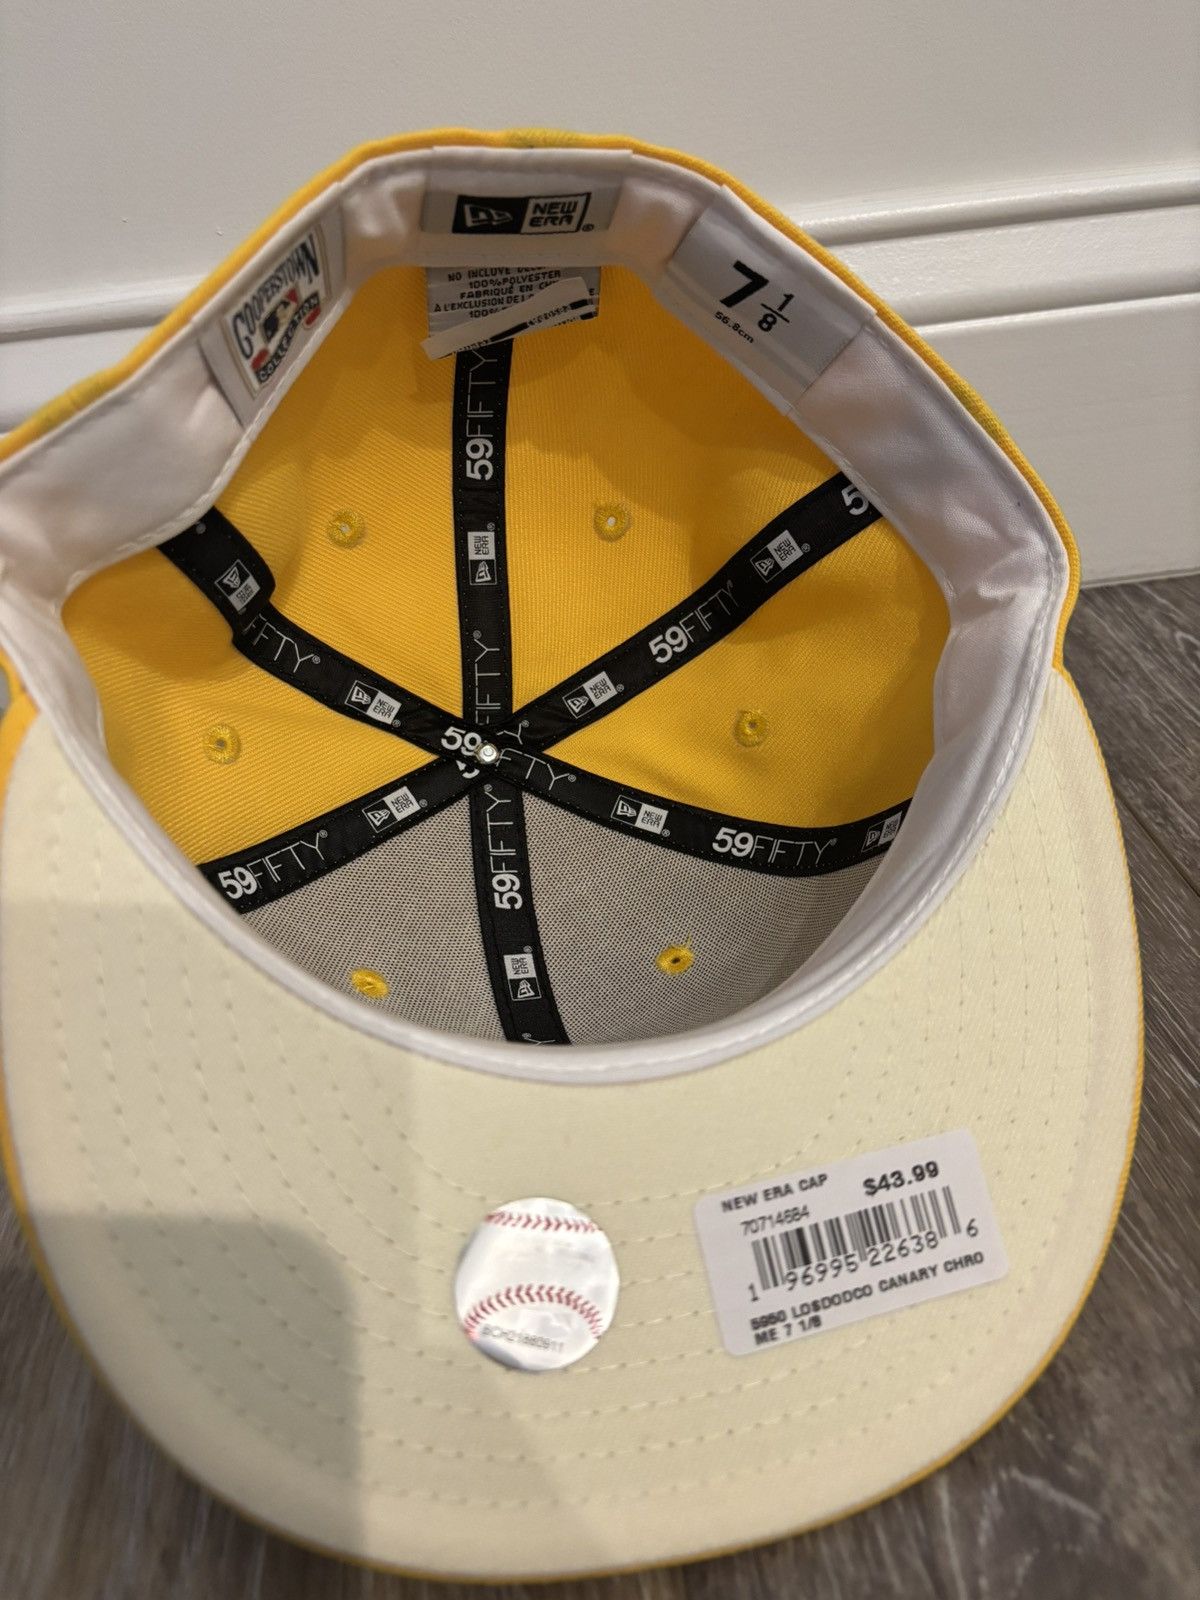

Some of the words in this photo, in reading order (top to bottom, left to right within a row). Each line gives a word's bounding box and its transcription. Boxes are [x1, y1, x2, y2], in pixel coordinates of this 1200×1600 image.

[531, 201, 578, 216] NEW
[529, 214, 573, 228] ERA
[448, 273, 462, 282] NO
[720, 260, 769, 308] 7
[232, 233, 320, 360] COOPERSTOWN
[519, 284, 533, 293] EN
[714, 311, 754, 343] 56.8cm
[474, 536, 482, 555] NEW
[481, 536, 489, 555] ERA
[589, 677, 607, 693] NEW
[594, 685, 611, 700] ERA
[373, 706, 391, 718] ERA
[377, 699, 395, 712] NEW
[391, 792, 408, 806] NEW
[396, 799, 414, 813] ERA
[641, 817, 660, 828] ERA
[644, 810, 663, 821] NEW
[485, 791, 523, 910] 59FIFTY
[712, 827, 832, 866] 59FIFTY
[218, 832, 325, 899] 59FIFTY
[863, 1161, 939, 1196] $43.99
[721, 1193, 758, 1212] NEW
[763, 1184, 793, 1201] ERA
[800, 1173, 828, 1192] CAP
[748, 1284, 758, 1302] 1
[786, 1254, 858, 1291] 96995
[869, 1231, 939, 1267] 22638
[966, 1218, 979, 1238] 6
[878, 1264, 938, 1292] CANARY
[943, 1251, 984, 1274] CHRO
[755, 1329, 778, 1346] ME
[785, 1323, 793, 1337] 7
[800, 1314, 822, 1332] 1/8
